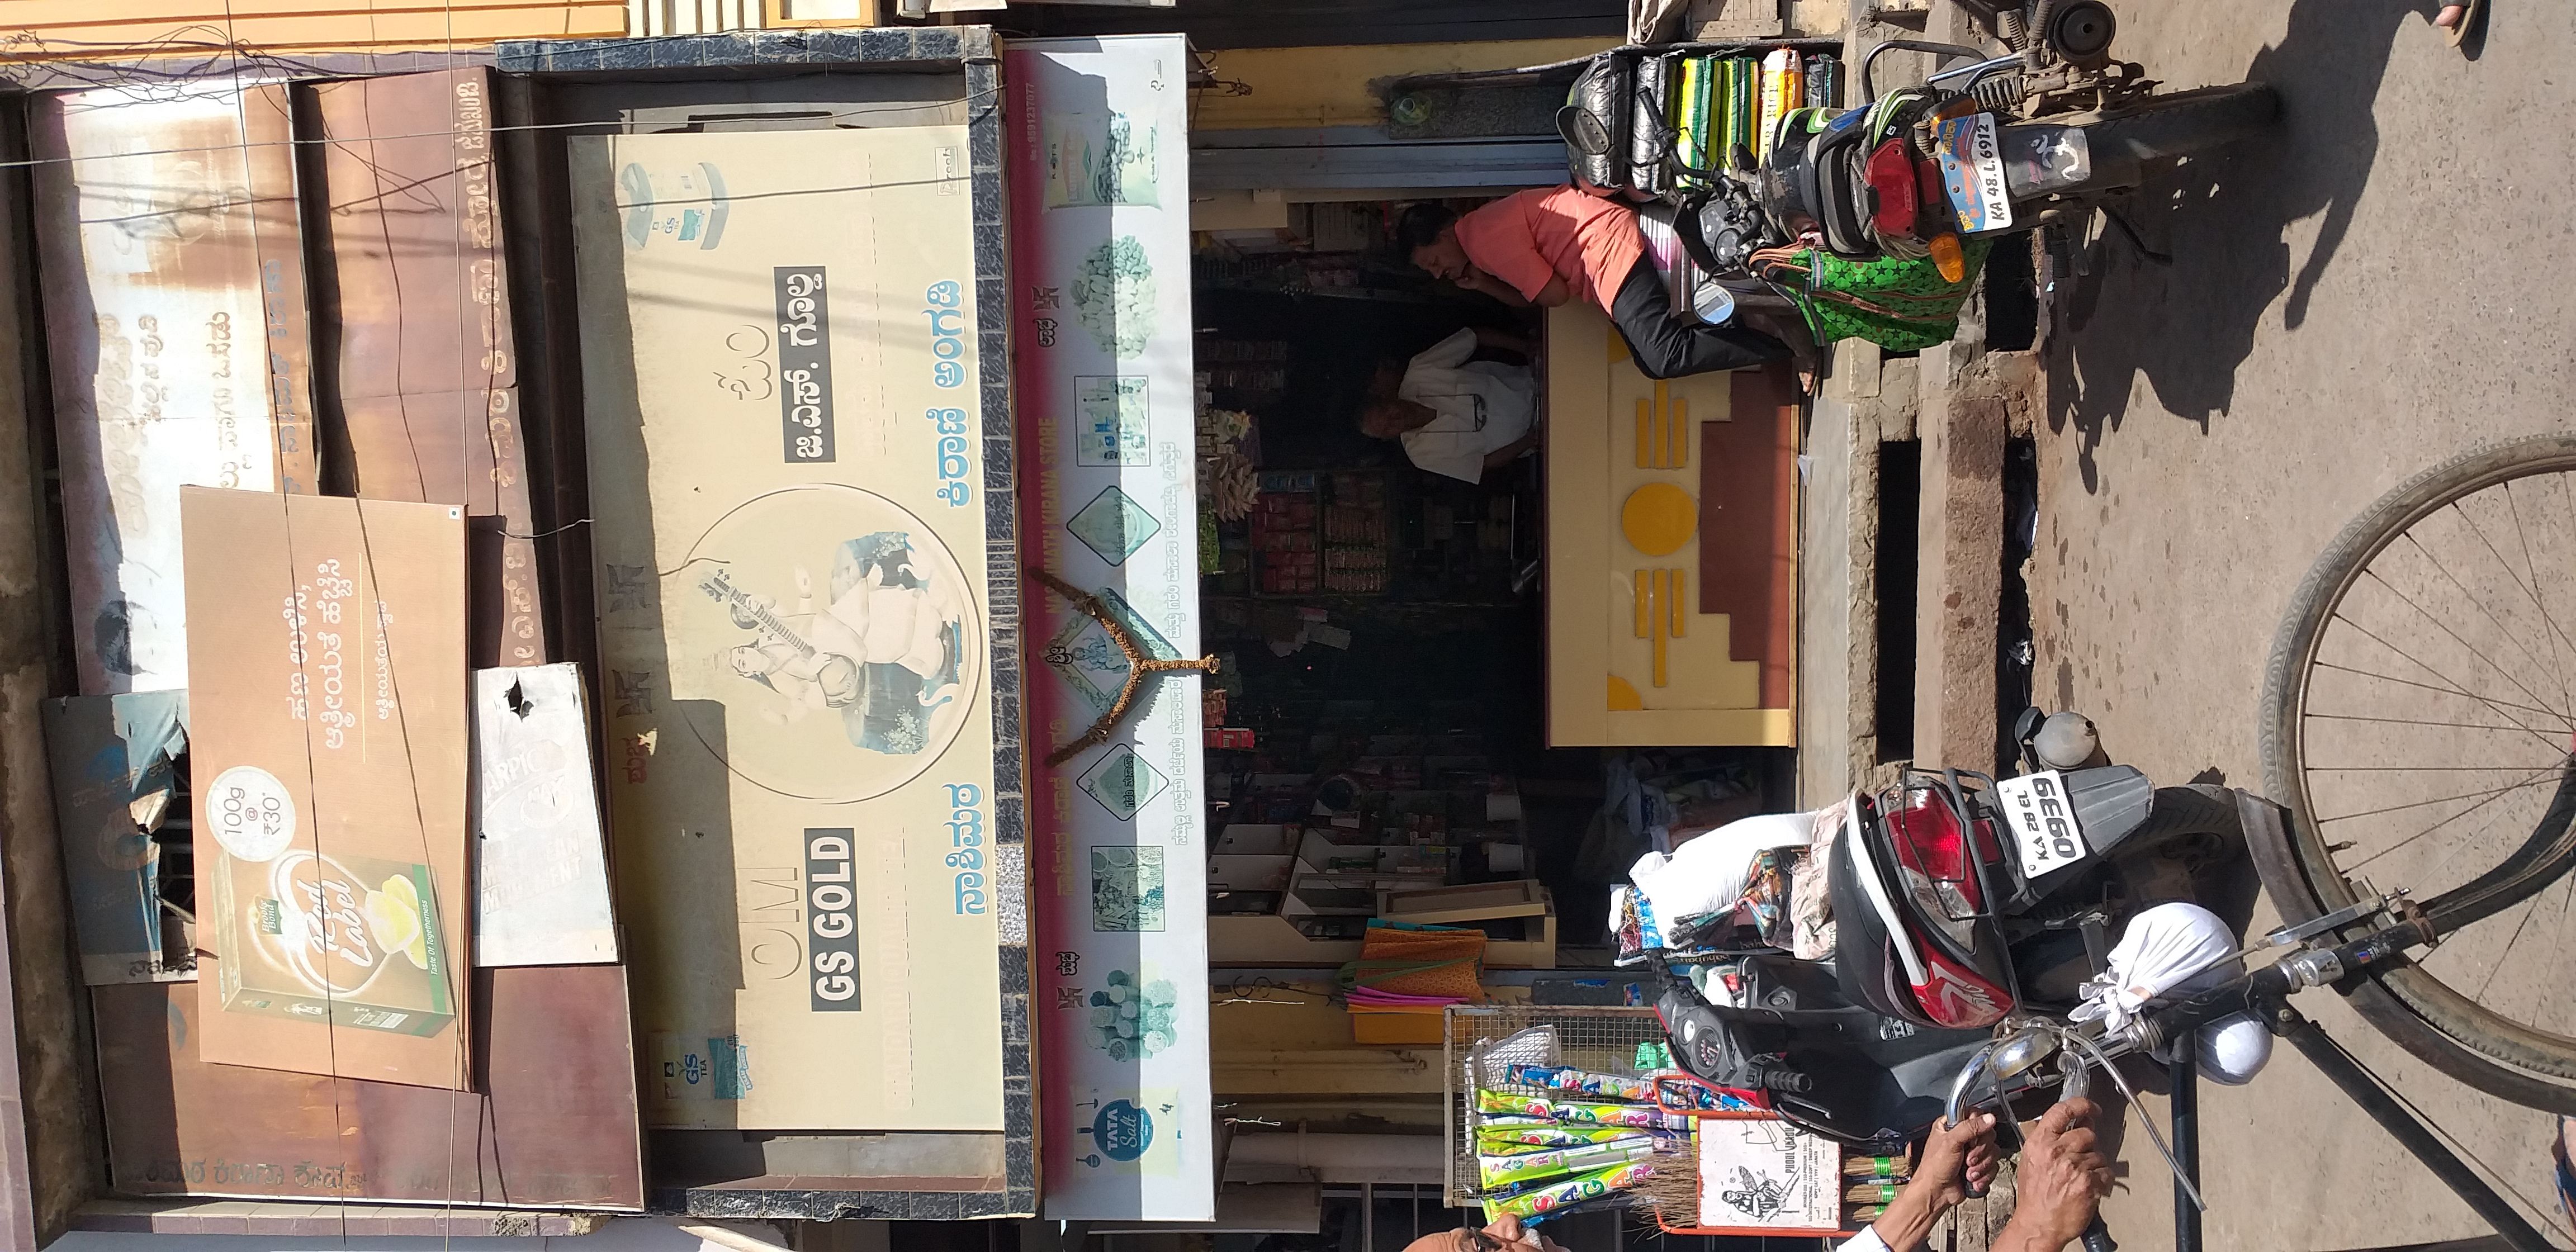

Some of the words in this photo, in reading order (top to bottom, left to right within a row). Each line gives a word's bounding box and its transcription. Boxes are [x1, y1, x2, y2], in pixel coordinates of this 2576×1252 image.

[1025, 82, 1036, 142] 9591237077
[1767, 85, 1778, 117] RICE
[665, 217, 675, 234] GS
[1990, 202, 2005, 220] KA
[922, 279, 967, 388] ಅಂಗಡಿ
[1033, 318, 1057, 347] ಲಾಭ
[1038, 416, 1058, 464] STORE
[1040, 471, 1059, 525] KIRANA
[1042, 529, 1062, 614] NASIMATH
[1163, 586, 1180, 609] ಗರಂ
[1163, 613, 1185, 638] ಮತ್ತು
[286, 672, 309, 720] ಹಣ
[1123, 756, 1134, 786] ಮಸಾಲಾ
[224, 787, 244, 836] 100g
[246, 808, 257, 821] @
[1123, 790, 1134, 807] ಗರಂ
[2018, 790, 2030, 808] EL
[2024, 813, 2039, 832] 28
[2032, 777, 2076, 858] 0939
[941, 782, 988, 916] ನಾಶಿಮಠ
[2033, 836, 2049, 860] KA
[810, 836, 853, 938] GOLD
[259, 900, 270, 932] Brooke
[267, 904, 276, 929] Bond
[297, 879, 338, 954] Red
[321, 880, 373, 966] Label
[420, 900, 433, 945] Togetherness
[738, 867, 802, 980] OM
[429, 957, 438, 975] Taste
[814, 951, 855, 1001] GS
[1055, 951, 1080, 976] ಶುಭ
[685, 1054, 699, 1084] GS
[1107, 1108, 1118, 1151] TATA
[1120, 1114, 1138, 1147] Salt
[1524, 1102, 1650, 1127] SAGAR
[1490, 1154, 1550, 1173] SAGAR
